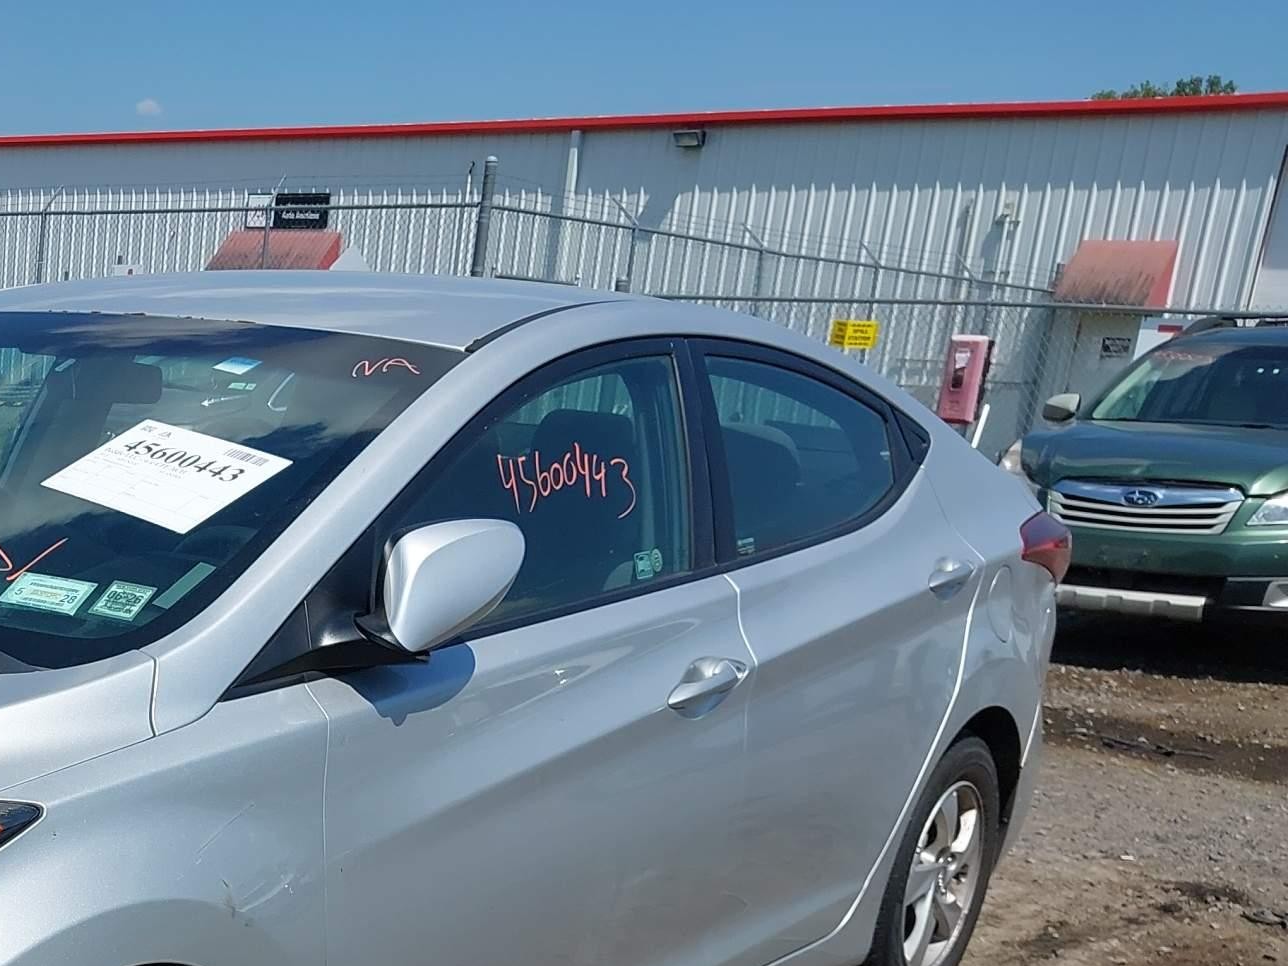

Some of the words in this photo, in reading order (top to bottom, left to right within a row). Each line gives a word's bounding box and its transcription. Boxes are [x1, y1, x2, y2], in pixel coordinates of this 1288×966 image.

[123, 438, 246, 483] 45600443
[497, 442, 636, 519] 45600443
[14, 587, 25, 597] 5
[59, 594, 78, 605] 28
